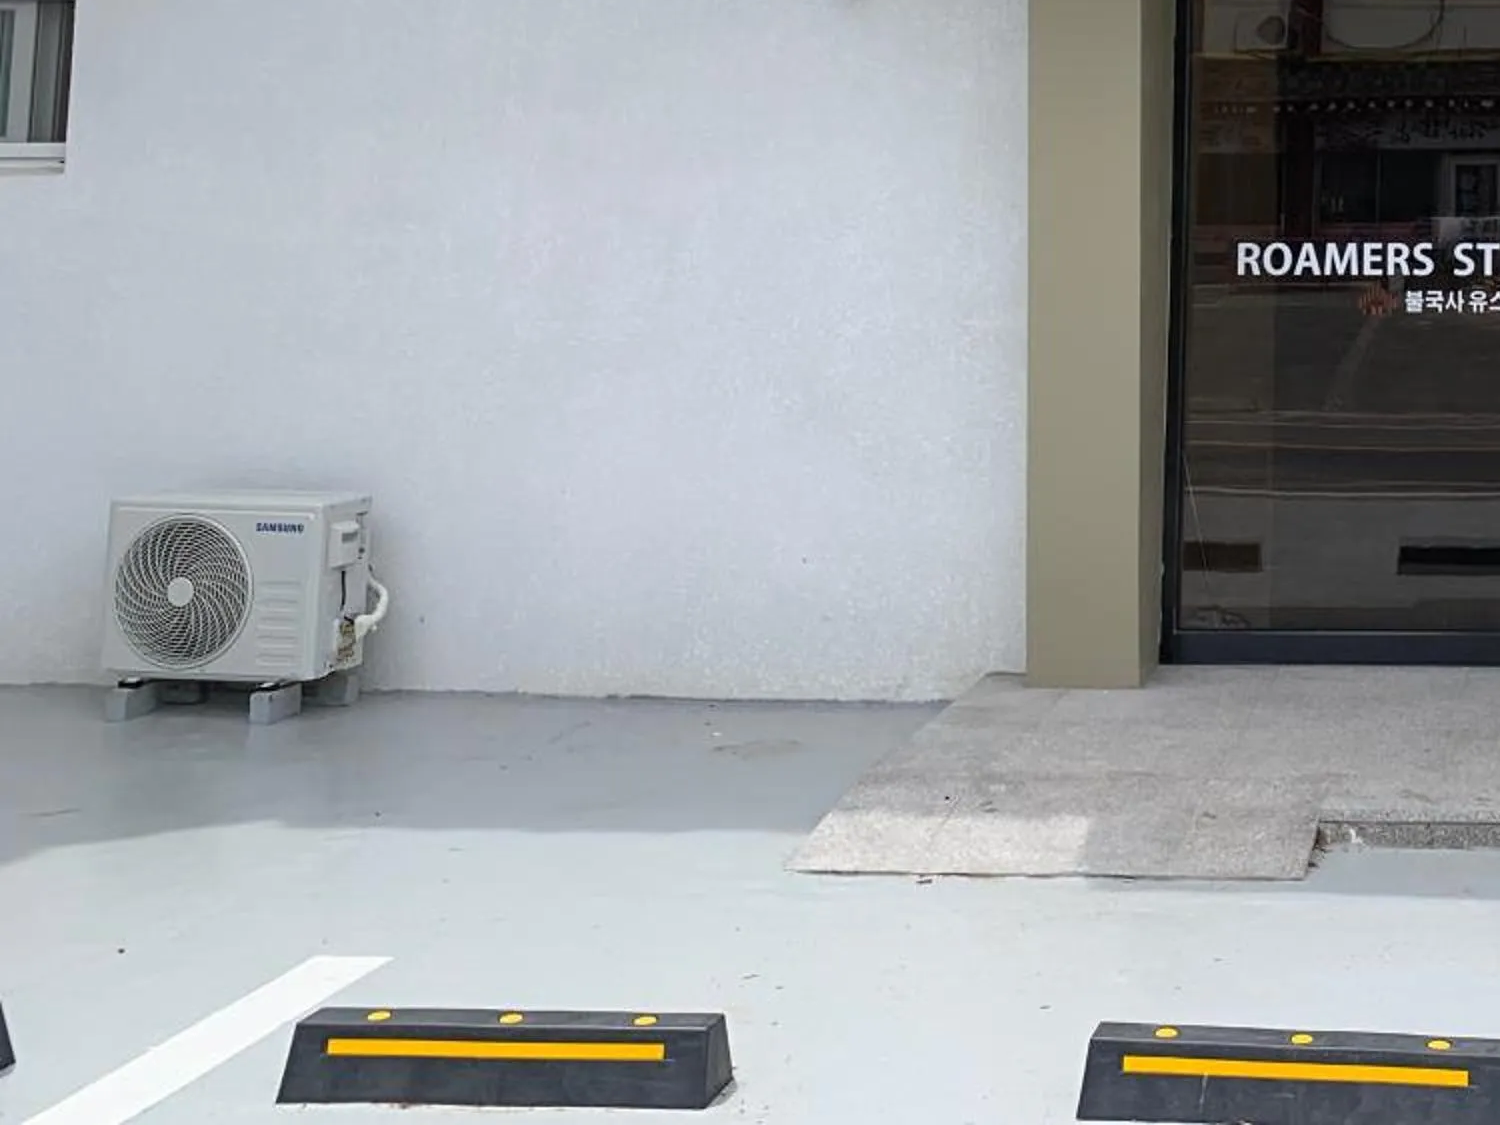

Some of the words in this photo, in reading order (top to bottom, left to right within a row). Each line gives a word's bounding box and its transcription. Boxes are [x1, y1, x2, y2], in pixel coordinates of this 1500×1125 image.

[1236, 242, 1434, 276] ROAMERS
[1404, 289, 1464, 314] 불국사
[255, 522, 305, 534] SAMSUNG
